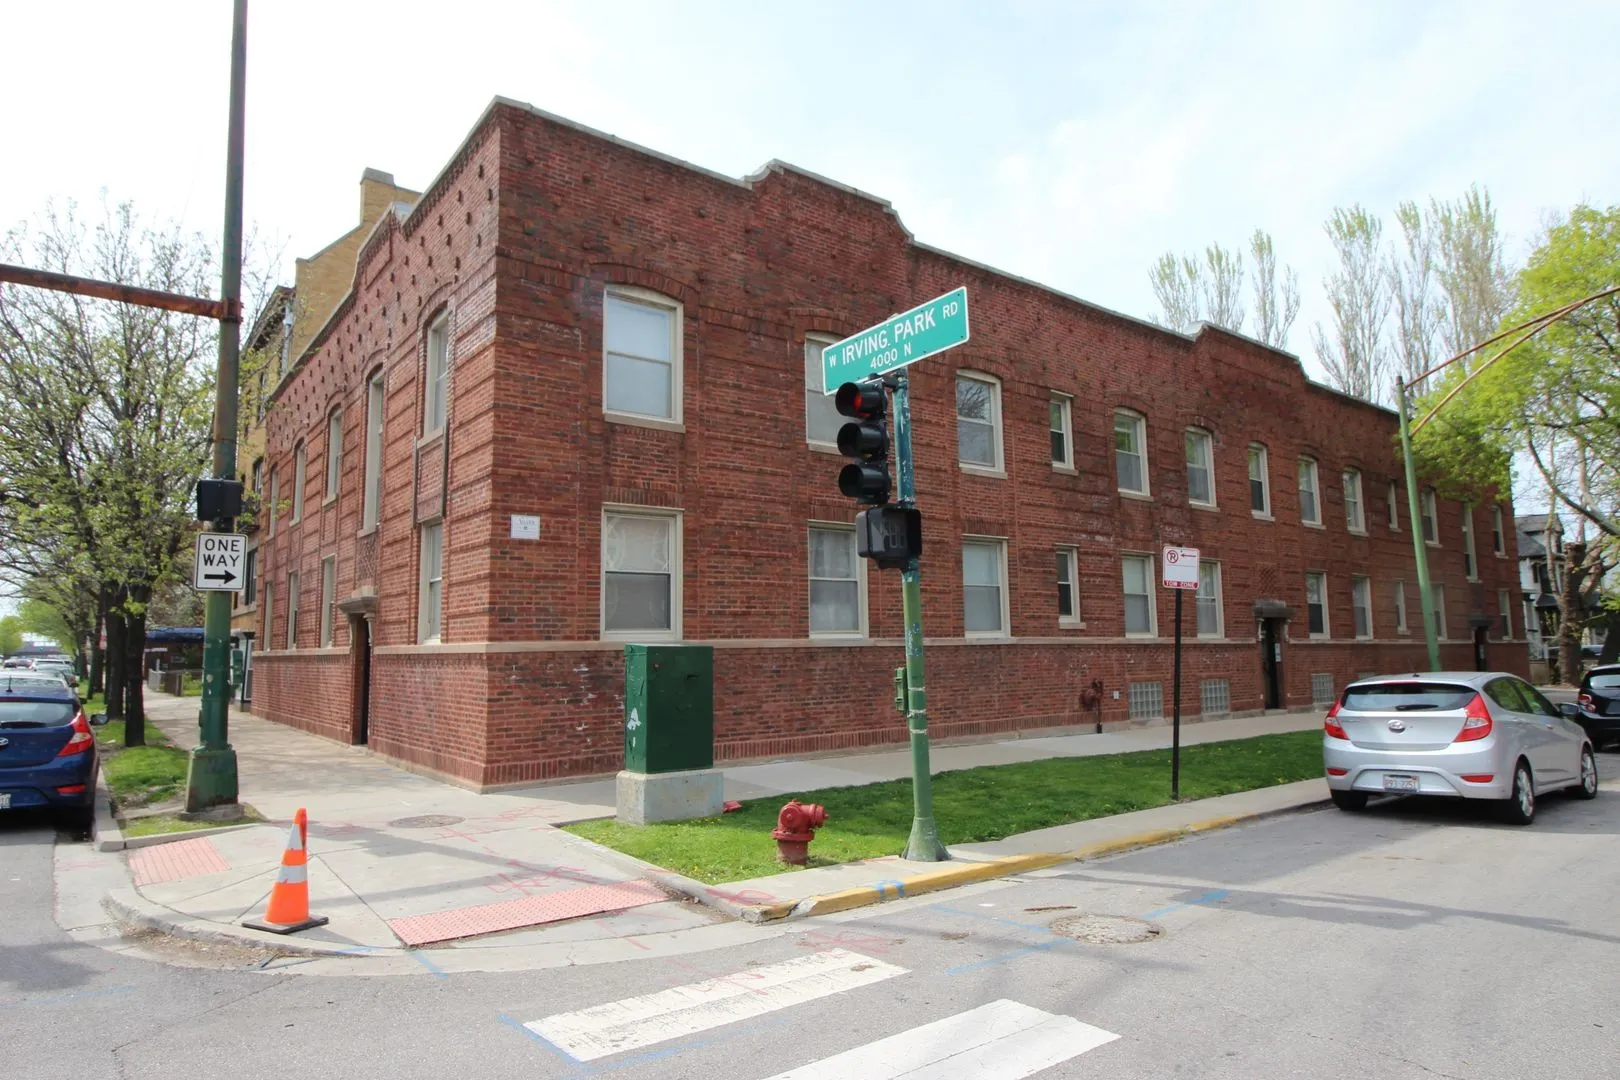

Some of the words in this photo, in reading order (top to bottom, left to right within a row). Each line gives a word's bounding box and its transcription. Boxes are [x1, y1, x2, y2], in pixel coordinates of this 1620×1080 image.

[829, 355, 837, 368] W
[842, 330, 888, 365] IRVING
[894, 308, 936, 343] PARK
[943, 301, 958, 319] RD
[870, 348, 898, 369] 4000
[904, 342, 912, 356] N
[205, 538, 240, 552] ONE
[203, 553, 240, 567] WAY
